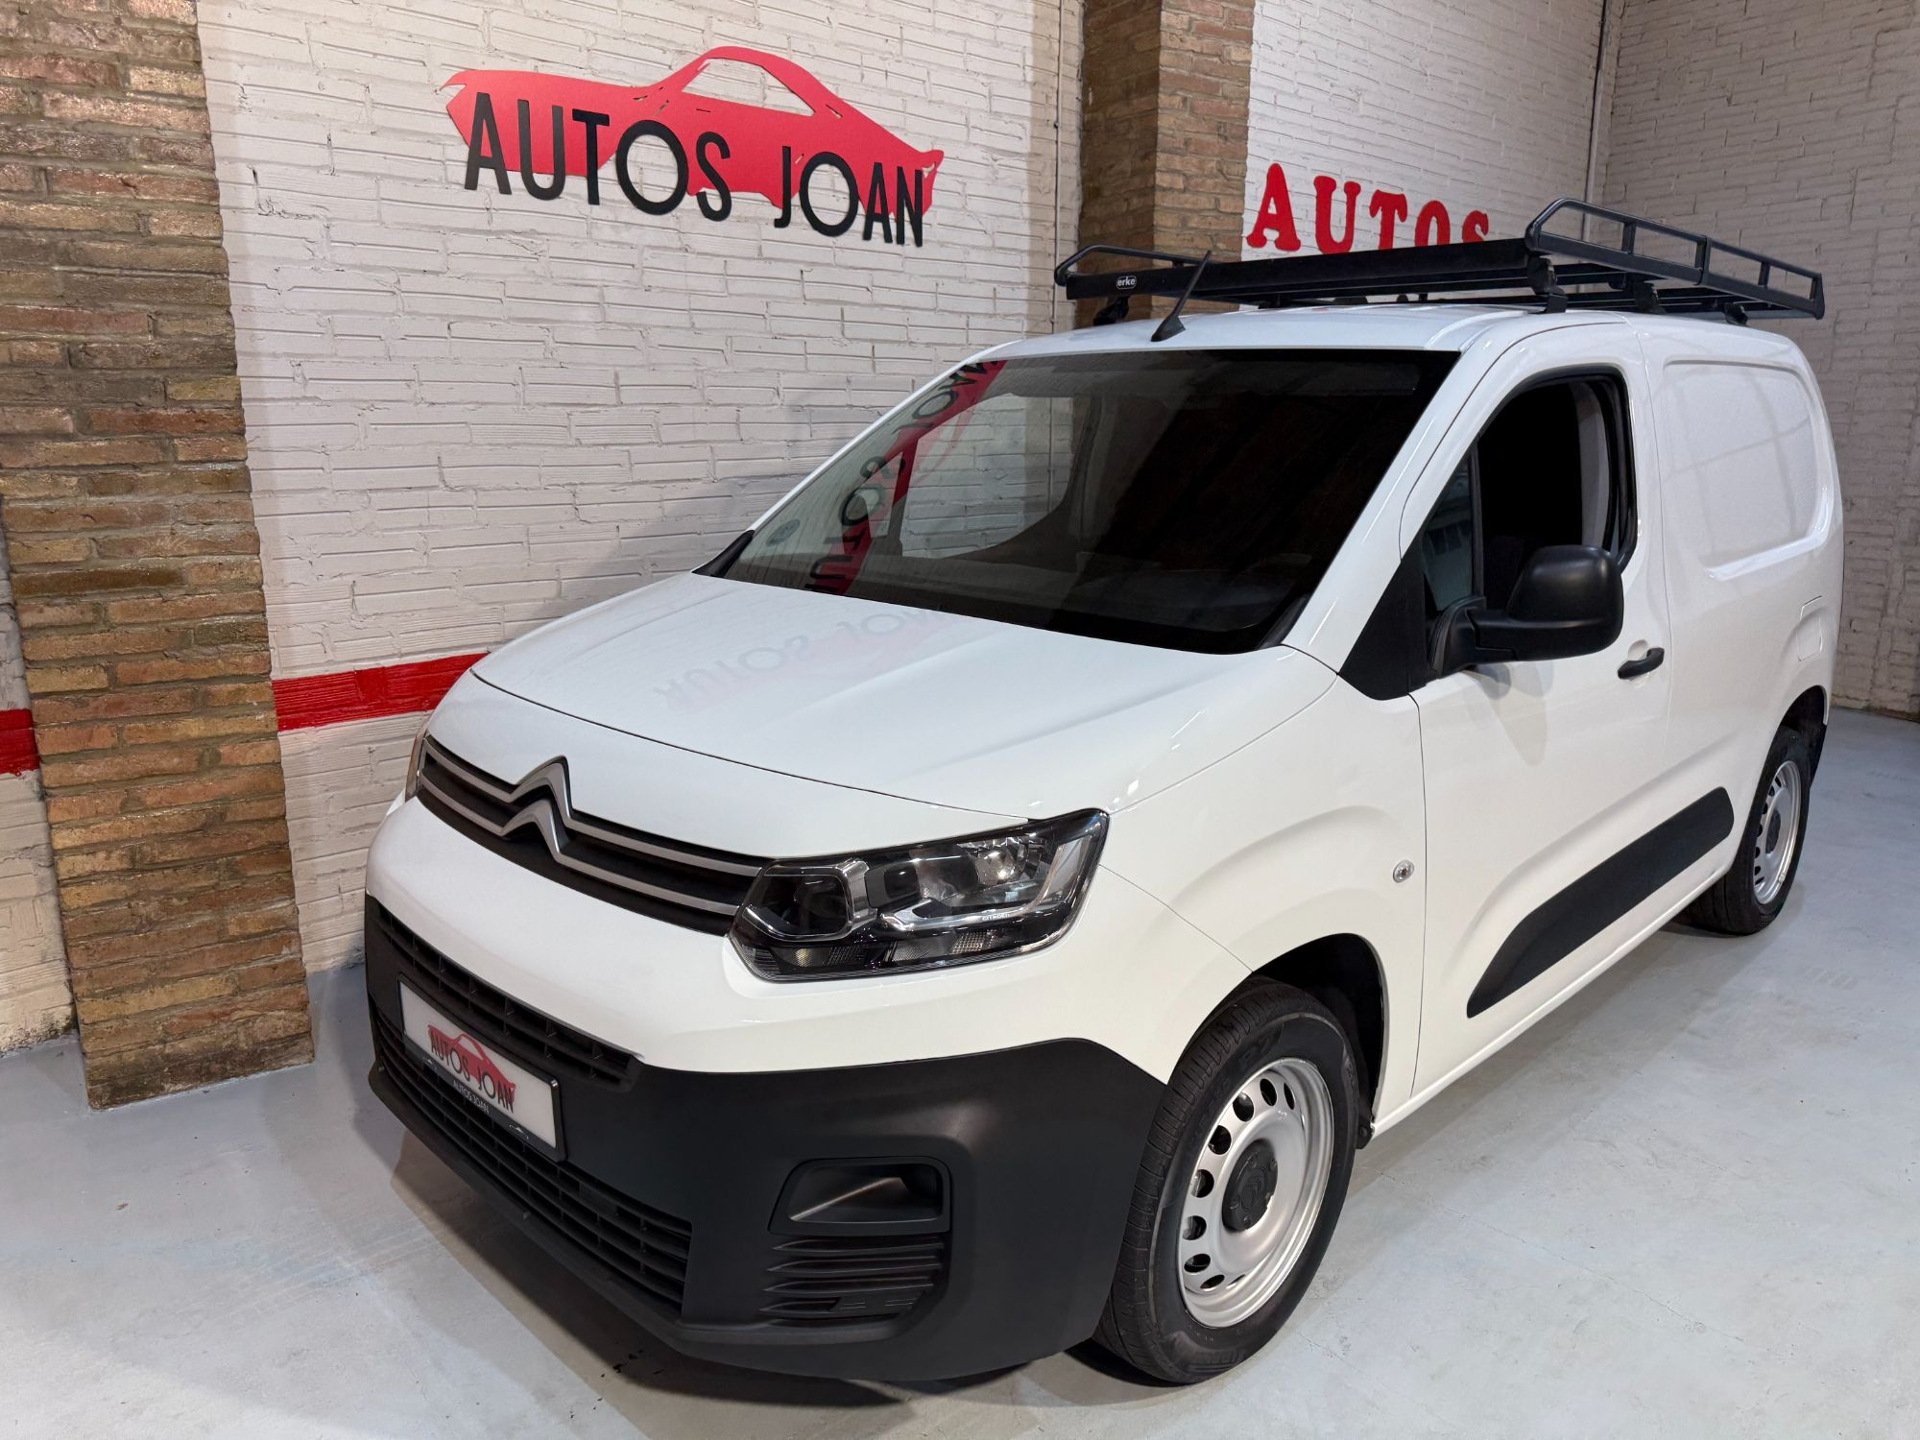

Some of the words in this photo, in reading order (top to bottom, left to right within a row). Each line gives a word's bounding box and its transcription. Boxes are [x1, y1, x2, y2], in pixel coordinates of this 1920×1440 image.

[464, 92, 732, 221] AUTOS
[773, 146, 923, 247] JOAN
[1246, 163, 1489, 254] AUTOS
[1117, 276, 1136, 286] erke
[431, 1031, 470, 1082] AUTOS
[477, 1064, 514, 1114] JOAN
